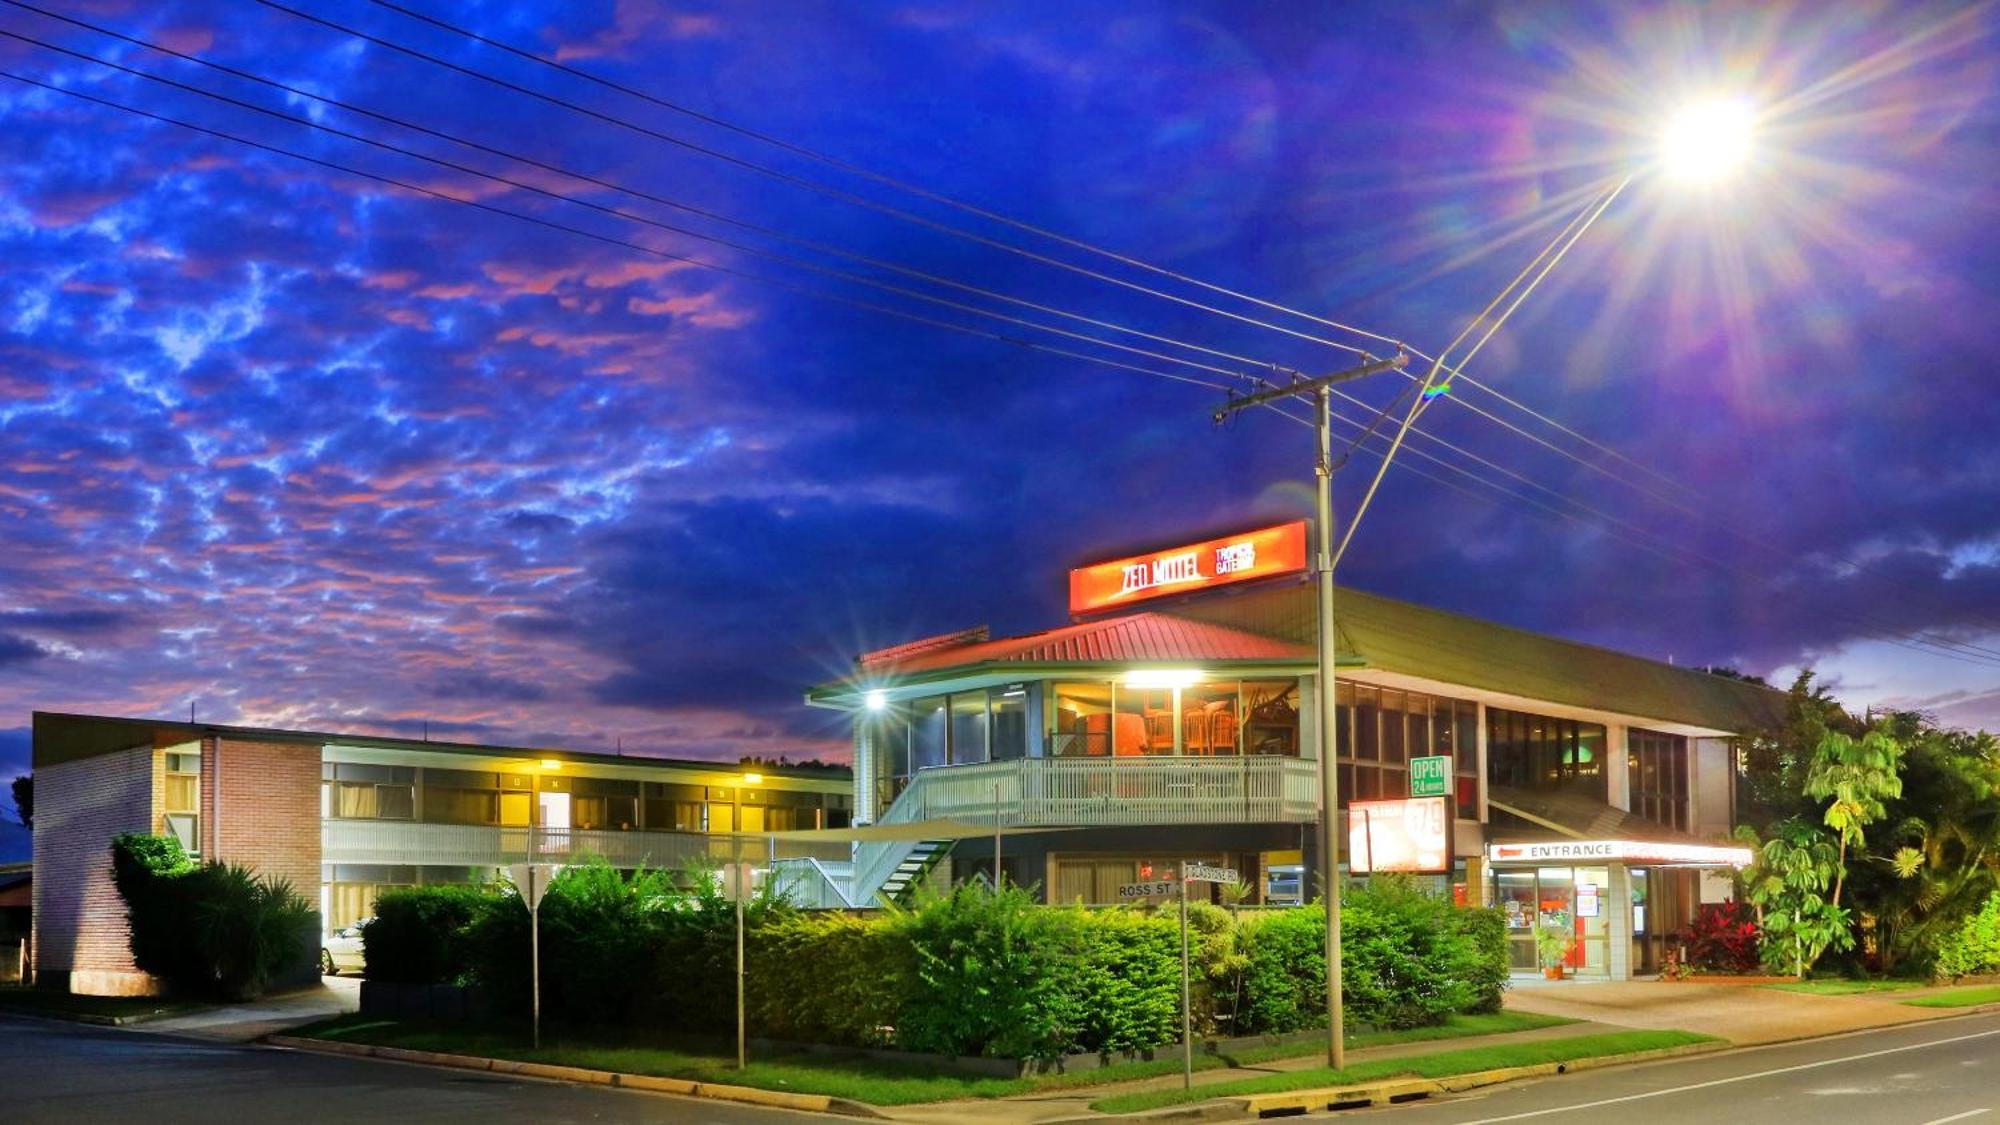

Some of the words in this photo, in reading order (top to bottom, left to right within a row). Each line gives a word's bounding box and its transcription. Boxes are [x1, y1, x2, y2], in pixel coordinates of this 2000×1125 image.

[1413, 760, 1444, 779] OPEN
[1414, 780, 1425, 793] 24
[1531, 844, 1612, 857] ENTRANCE
[1119, 885, 1151, 897] ROSS
[1157, 883, 1170, 894] ST
